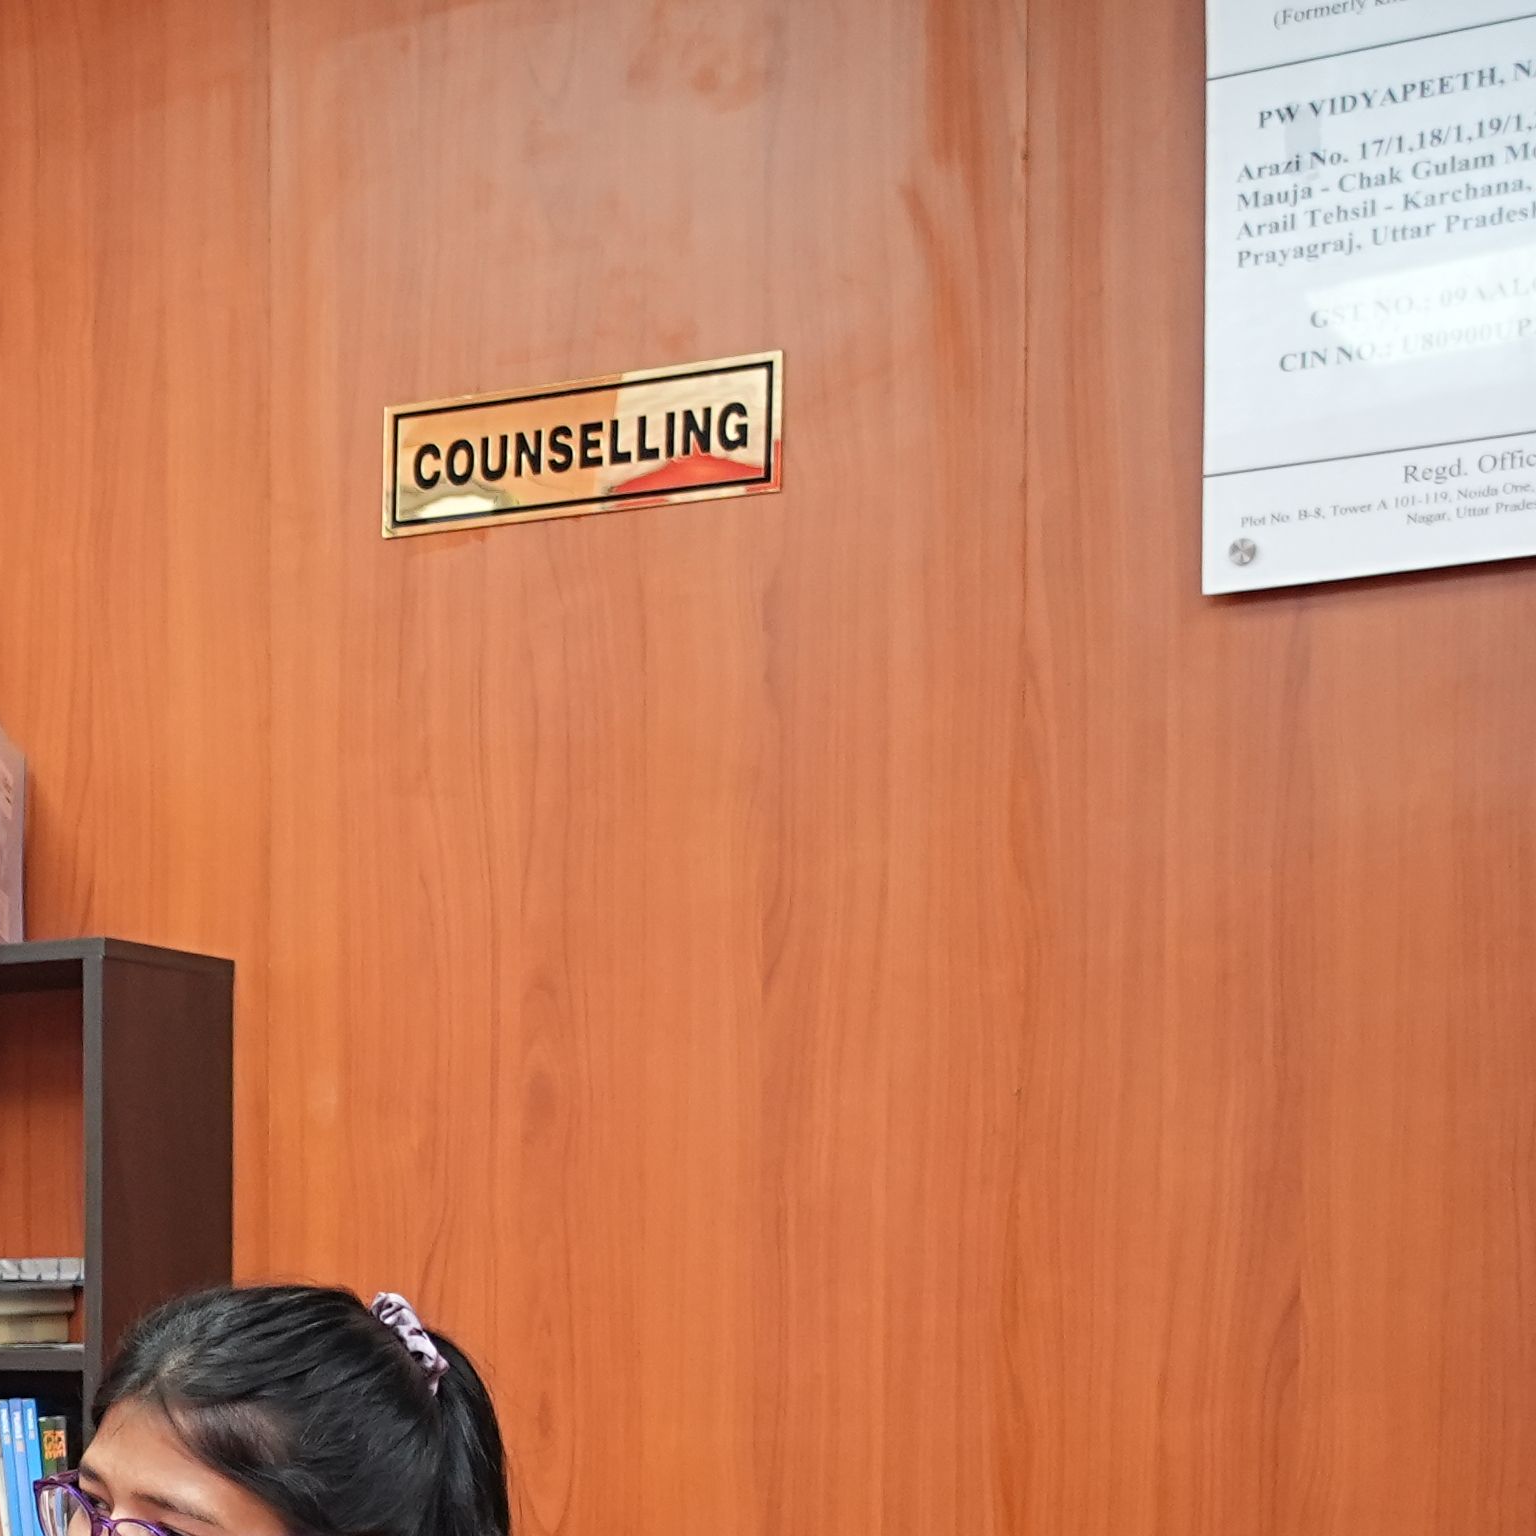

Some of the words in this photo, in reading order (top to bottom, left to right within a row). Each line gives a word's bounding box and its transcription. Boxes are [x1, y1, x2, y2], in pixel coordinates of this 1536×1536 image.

[1258, 103, 1300, 130] PW
[1308, 66, 1505, 119] VIDYAPEETH,
[1237, 155, 1301, 183] Arazi
[1310, 149, 1349, 170] No.
[1237, 184, 1313, 212] Mauja
[1338, 166, 1403, 193] Chak
[1412, 153, 1495, 181] Gulam
[1237, 213, 1296, 241] Arail
[1304, 200, 1376, 229] Tehsil
[1401, 176, 1531, 213] Karchana,
[1237, 233, 1362, 269] Prayagraj,
[1372, 221, 1435, 246] Uttar
[1310, 303, 1364, 329] GST
[1279, 348, 1328, 373] CIN
[412, 401, 749, 490] COUNSELLING
[1403, 459, 1468, 484] Regd.
[1241, 515, 1266, 528] Plot
[1329, 502, 1372, 517] Tower
[1376, 499, 1389, 510] A
[1456, 485, 1498, 500] Noida
[1406, 509, 1452, 526] Nagar,
[1456, 504, 1490, 520] Uttar
